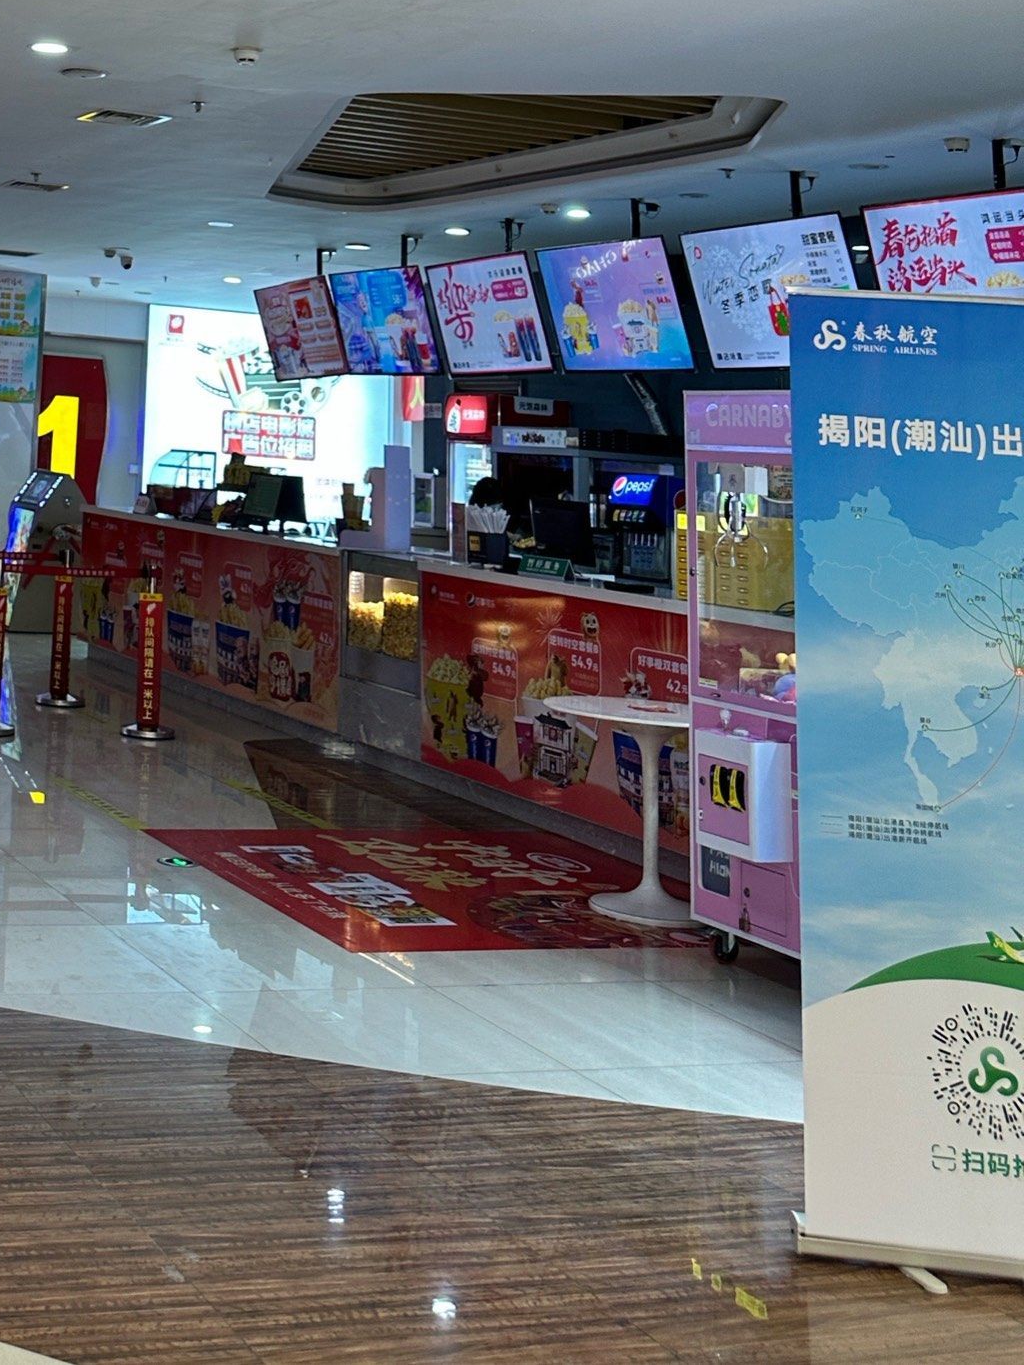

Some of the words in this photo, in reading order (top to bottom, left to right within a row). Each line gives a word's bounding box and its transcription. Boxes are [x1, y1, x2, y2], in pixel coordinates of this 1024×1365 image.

[851, 321, 938, 346] 春秋航空
[852, 343, 887, 354] SPRING
[893, 346, 938, 356] AIRLINES
[37, 395, 80, 479] 1
[818, 413, 1024, 460] 揭阳(潮汕)出
[625, 478, 657, 494] pepsi
[142, 616, 155, 721] 排队间隔请在一米以上
